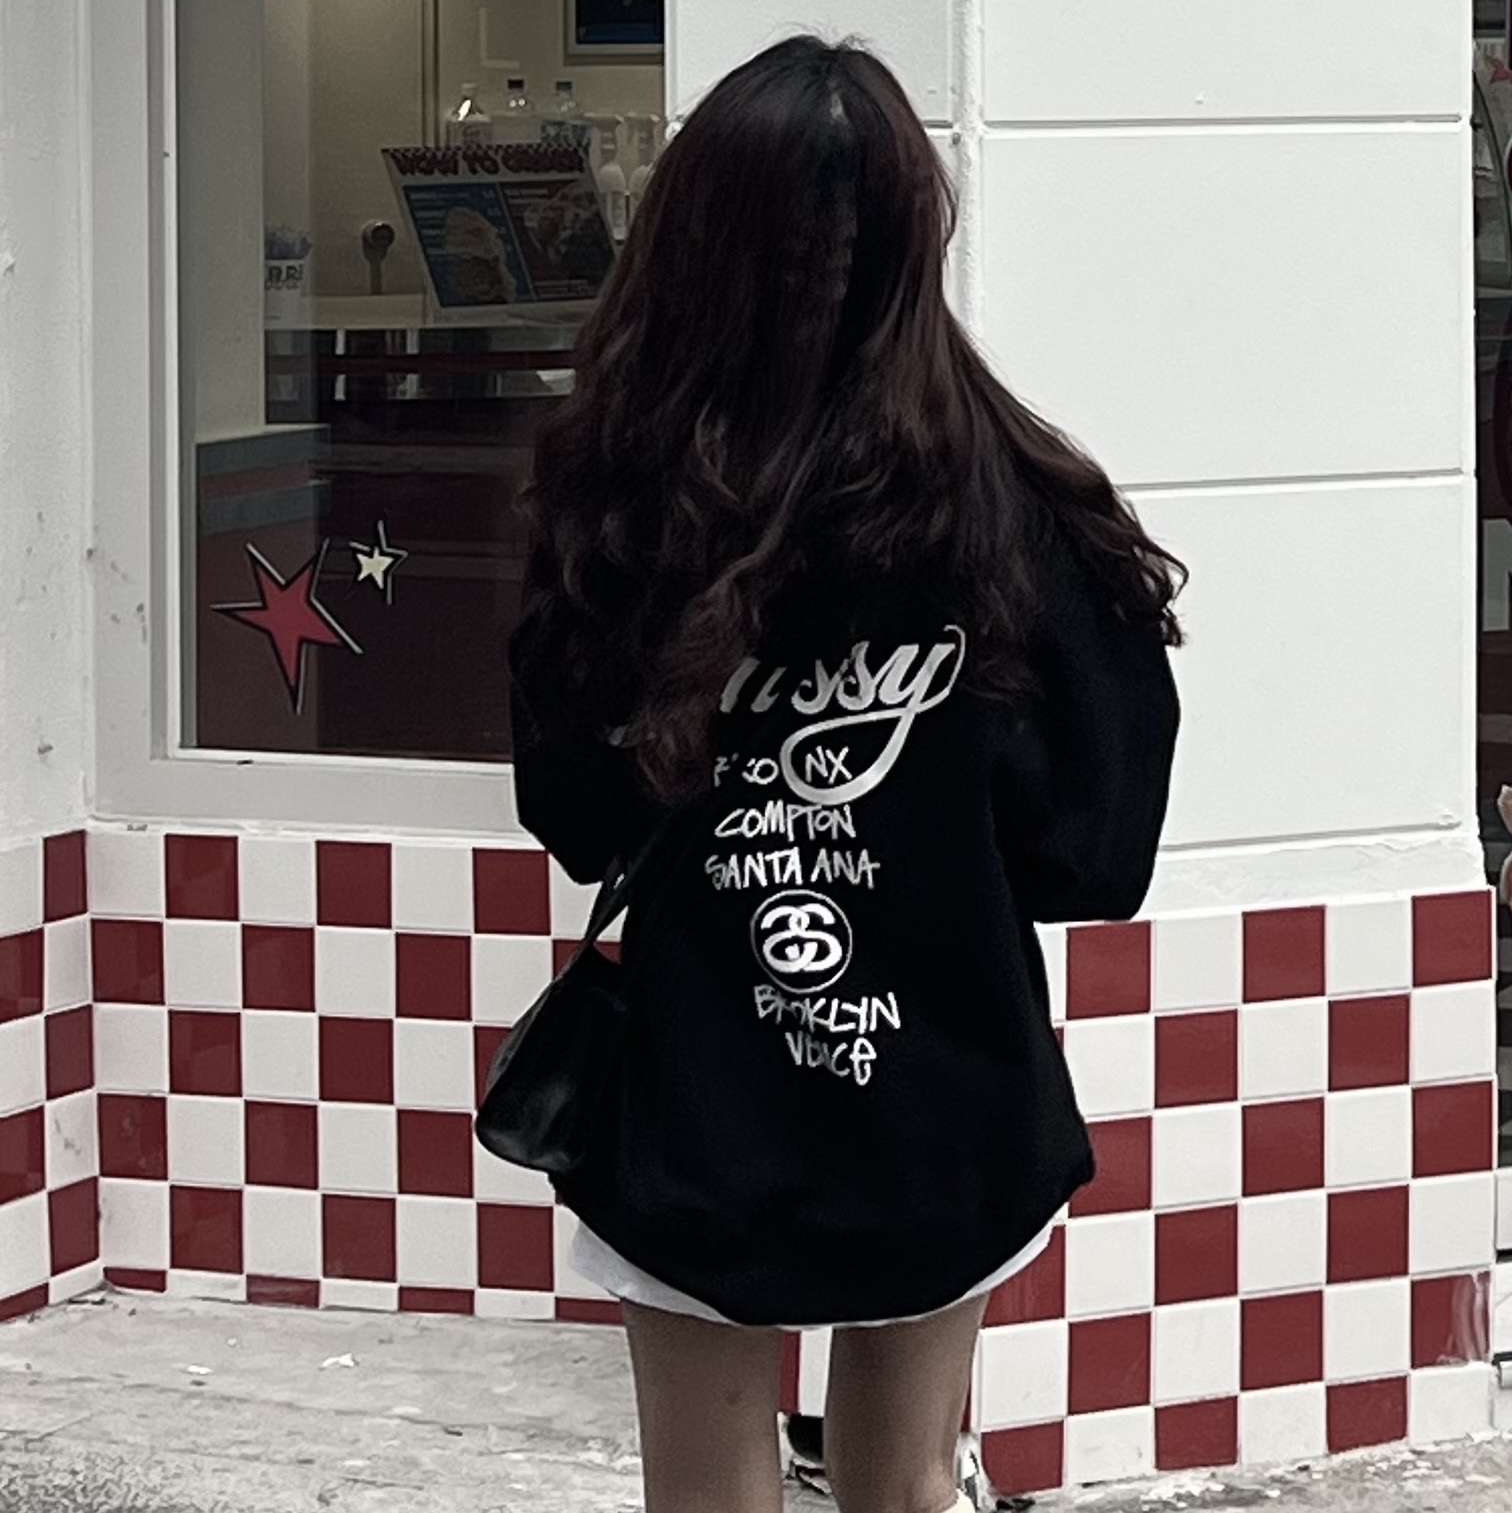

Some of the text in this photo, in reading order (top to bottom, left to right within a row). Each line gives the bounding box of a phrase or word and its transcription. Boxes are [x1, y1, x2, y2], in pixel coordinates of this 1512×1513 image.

[714, 799, 857, 842] COMPTON
[704, 846, 881, 890] SANTA ANA
